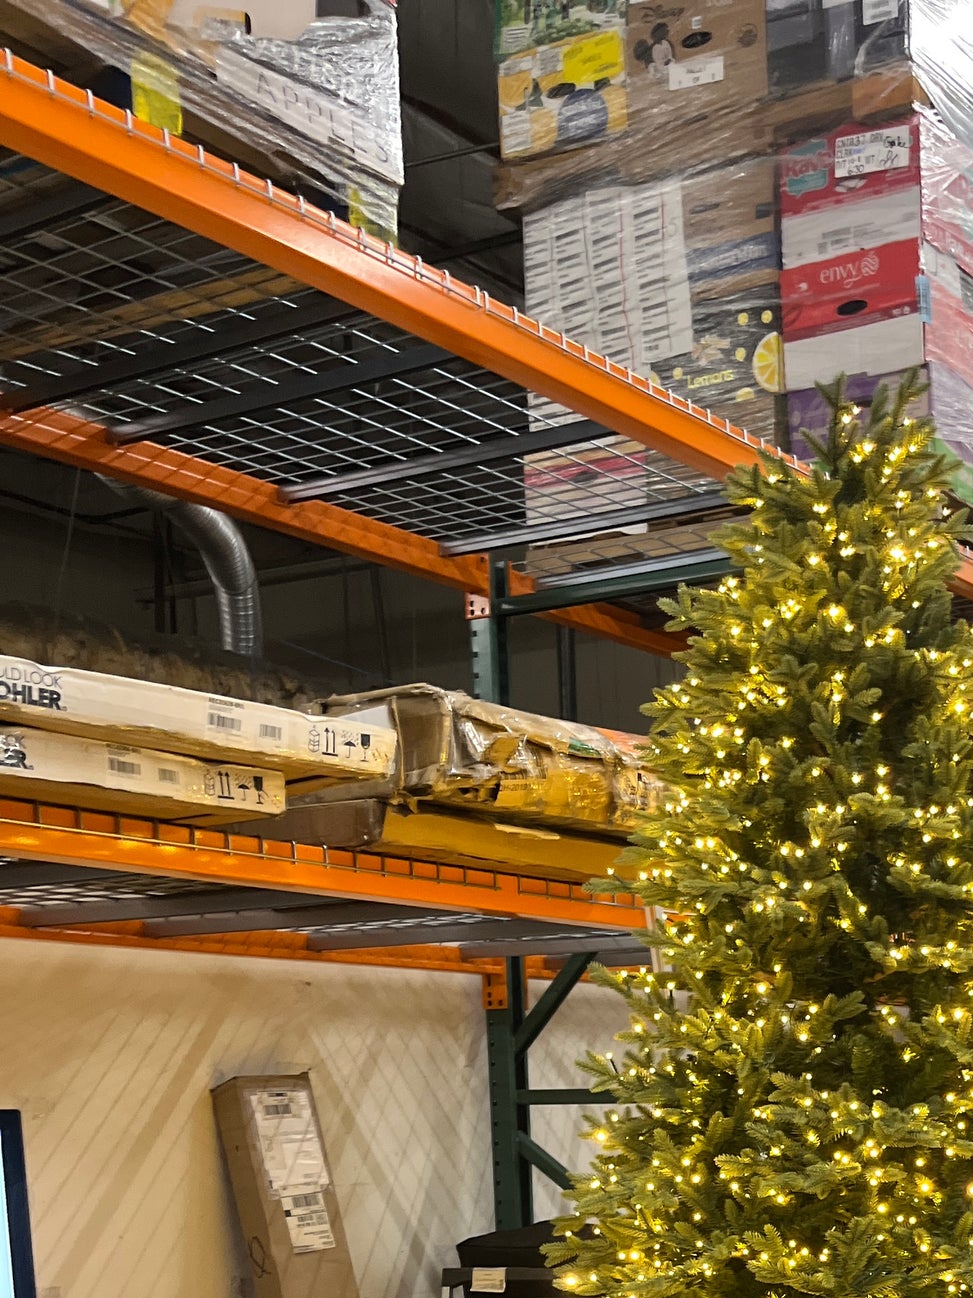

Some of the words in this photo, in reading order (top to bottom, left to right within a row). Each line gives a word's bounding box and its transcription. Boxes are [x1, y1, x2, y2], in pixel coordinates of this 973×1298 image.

[256, 71, 389, 163] APPLES
[820, 260, 861, 288] envy
[687, 370, 734, 389] Lemons
[24, 669, 63, 690] LOOK
